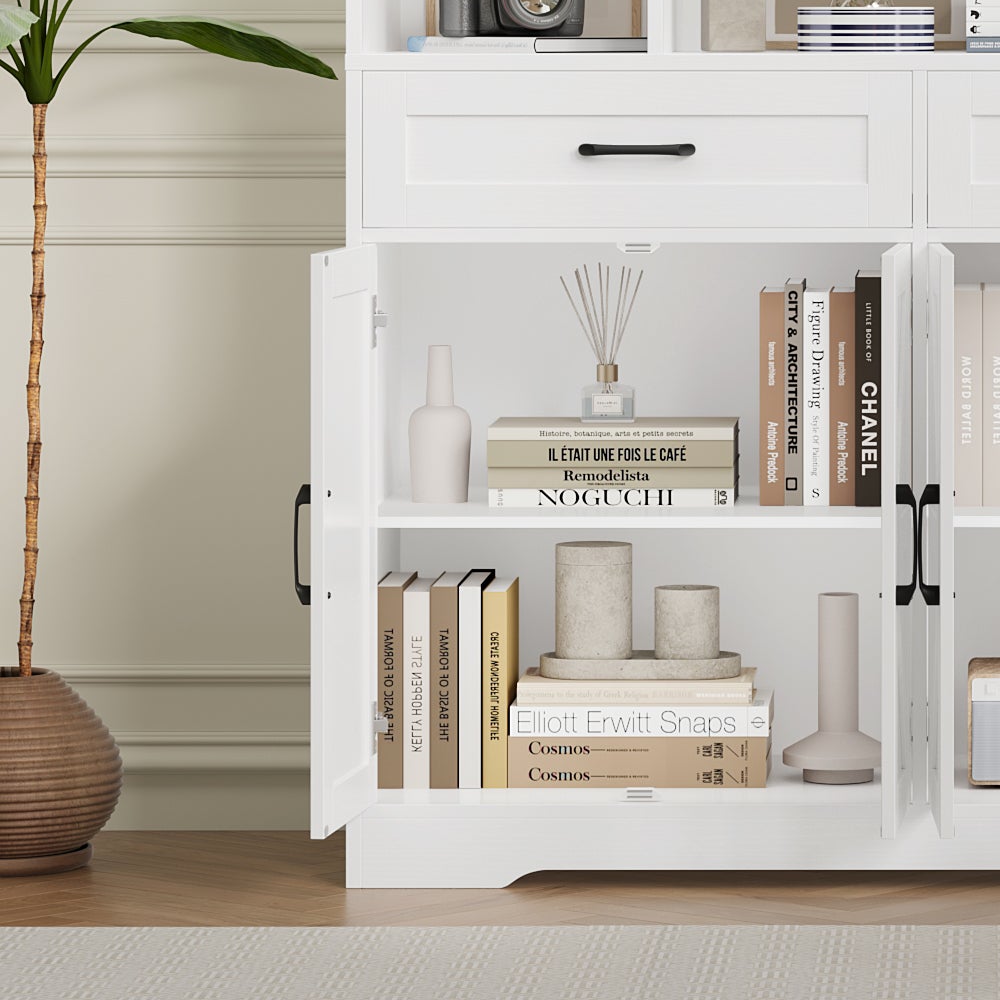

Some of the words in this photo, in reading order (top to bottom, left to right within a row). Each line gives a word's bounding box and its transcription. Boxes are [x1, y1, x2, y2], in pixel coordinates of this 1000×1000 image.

[788, 291, 798, 323] CITY
[788, 328, 798, 338] &
[808, 300, 824, 345] Figure
[866, 352, 871, 362] OF
[808, 351, 824, 409] Drawing
[788, 344, 798, 454] ARCHITECTURE
[767, 422, 779, 450] Antoine
[811, 416, 819, 433] Style
[837, 422, 848, 450] Antoine
[861, 382, 877, 476] CHANEL
[812, 435, 819, 444] Of
[549, 448, 558, 461] IL
[562, 445, 589, 461] ÉTAIT
[594, 448, 614, 461] UNE
[618, 448, 641, 461] FOIS
[644, 448, 656, 461] LE
[660, 445, 686, 461] CAFÉ
[811, 447, 819, 476] Painting
[564, 470, 649, 481] Remodelista
[767, 452, 779, 483] Predock
[837, 452, 848, 483] Predock
[538, 489, 673, 506] NOGUCHI
[518, 711, 577, 733] Elliott
[588, 711, 651, 733] Erwitt
[661, 711, 736, 736] Snaps
[528, 741, 590, 754] Cosmos
[528, 768, 590, 781] Cosmos
